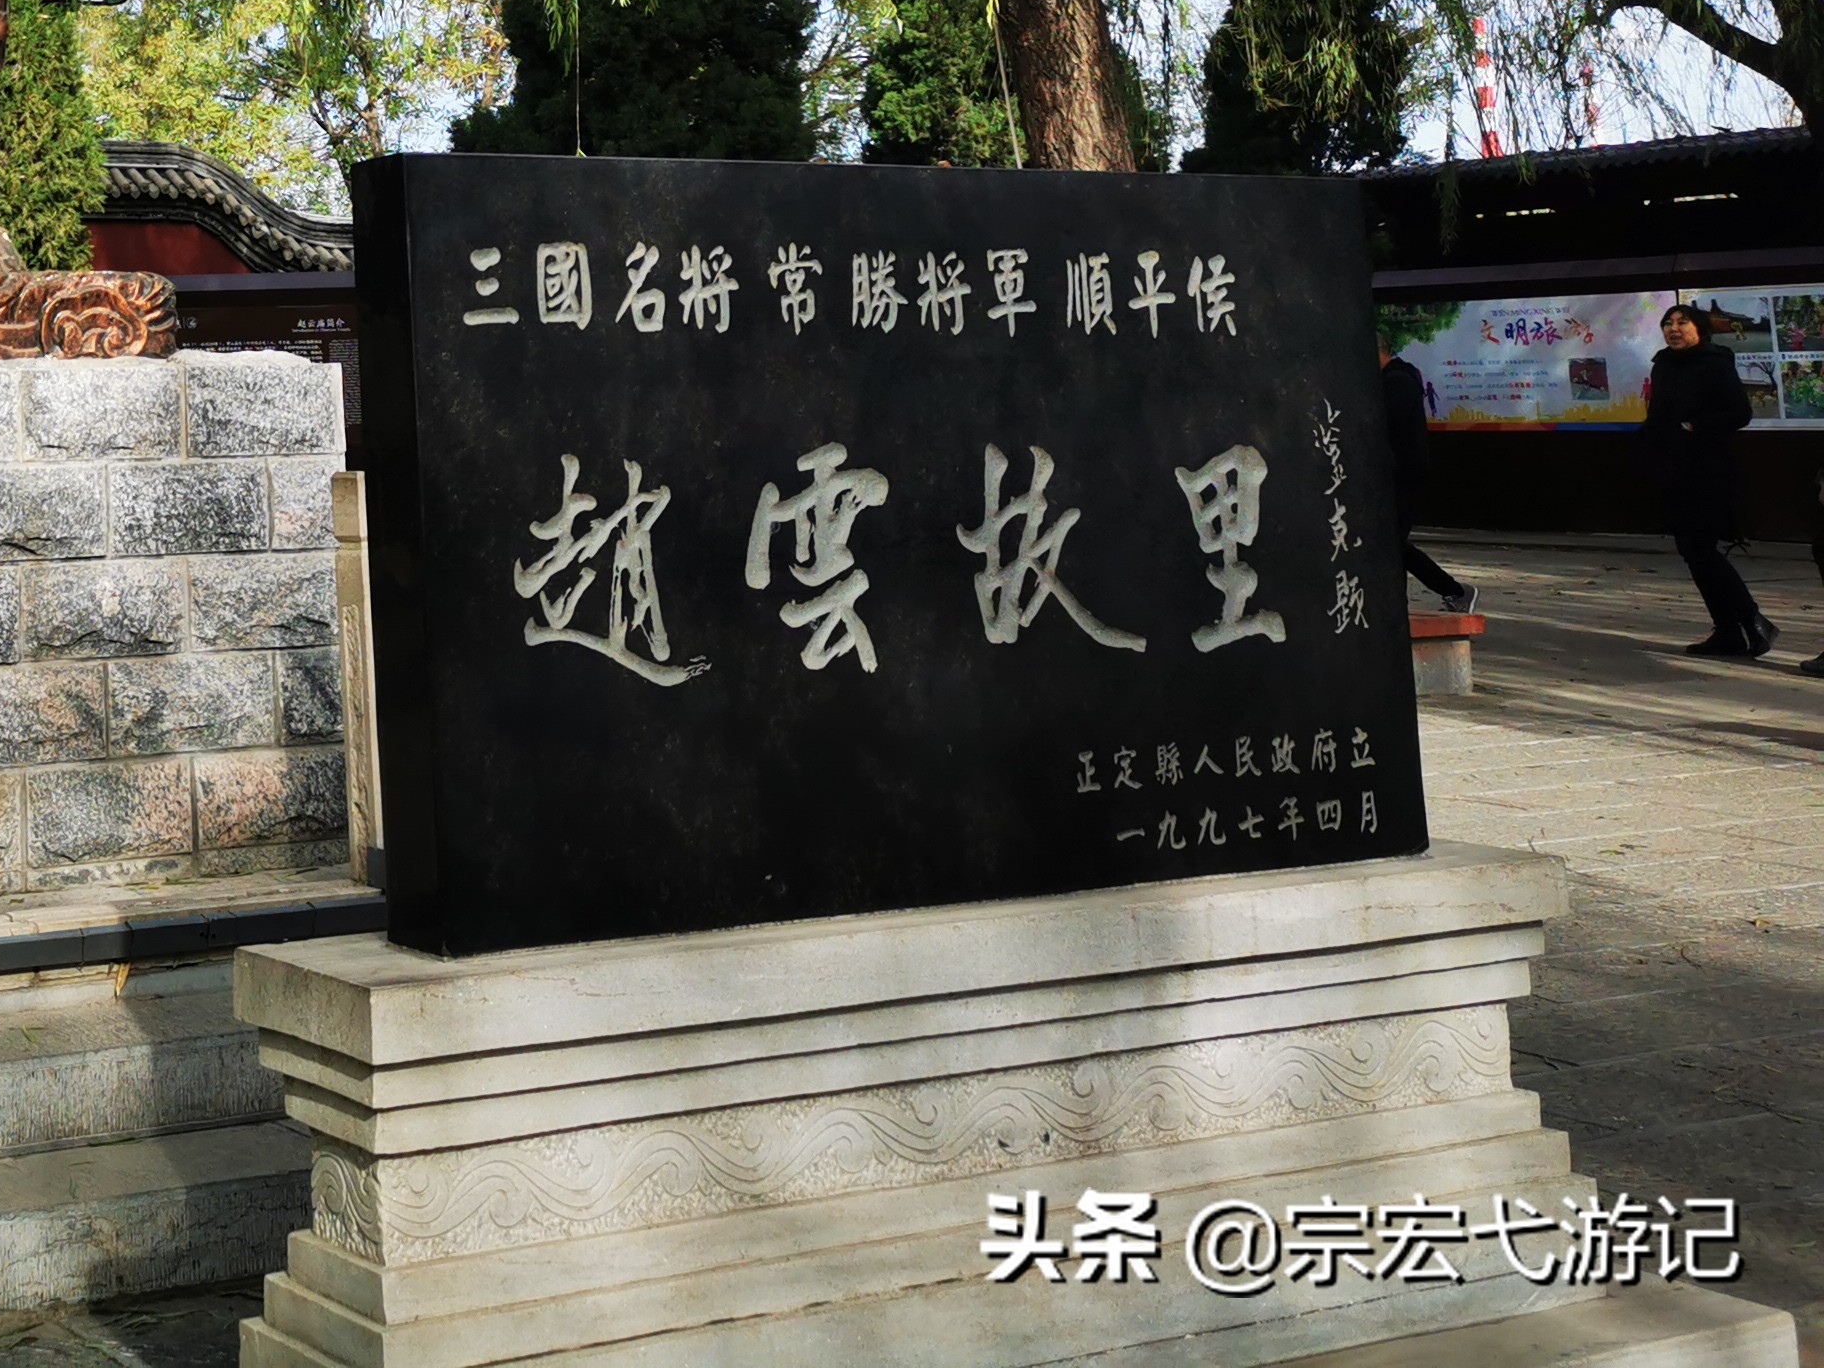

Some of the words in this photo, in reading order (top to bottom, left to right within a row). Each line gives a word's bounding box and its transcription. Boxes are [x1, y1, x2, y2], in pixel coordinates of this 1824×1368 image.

[1116, 789, 1378, 850] 一九九七年四月
